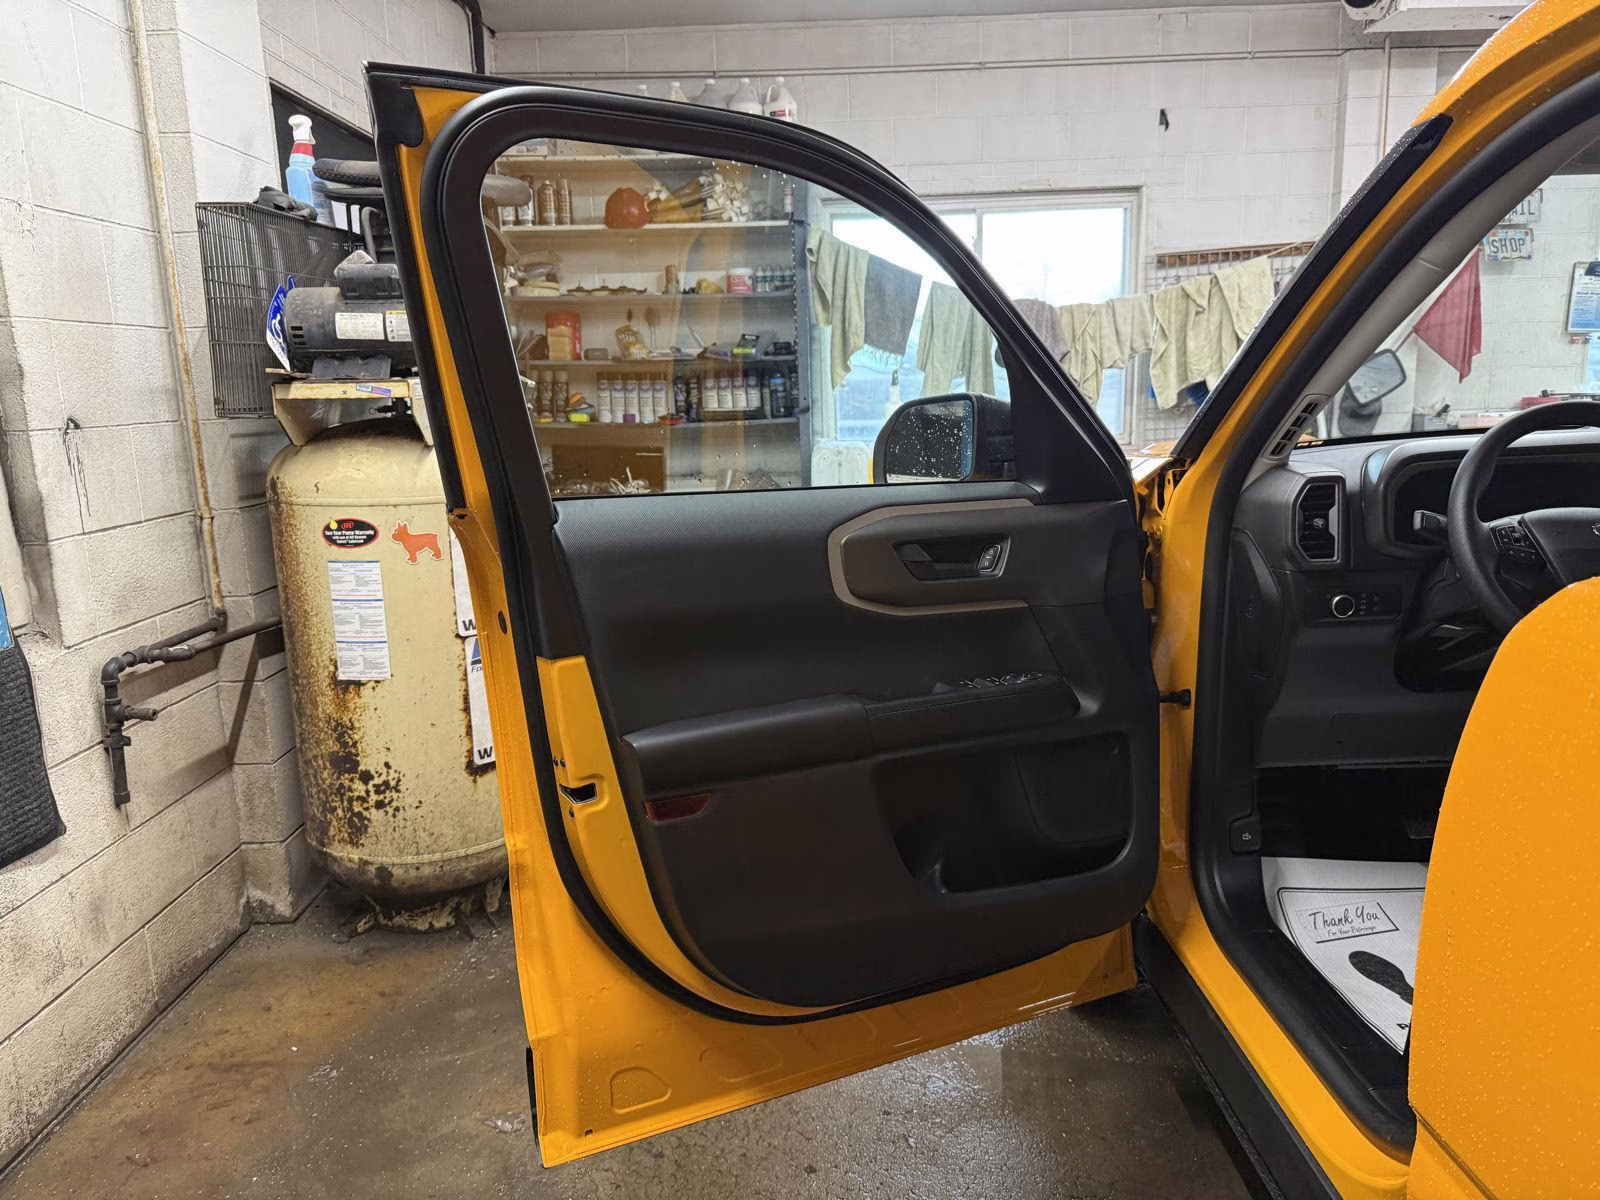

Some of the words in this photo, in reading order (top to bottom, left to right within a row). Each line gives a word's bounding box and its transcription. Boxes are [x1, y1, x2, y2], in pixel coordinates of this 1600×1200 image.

[1491, 237, 1525, 254] SHOP
[1308, 908, 1353, 930] Thank
[1355, 905, 1380, 924] You
